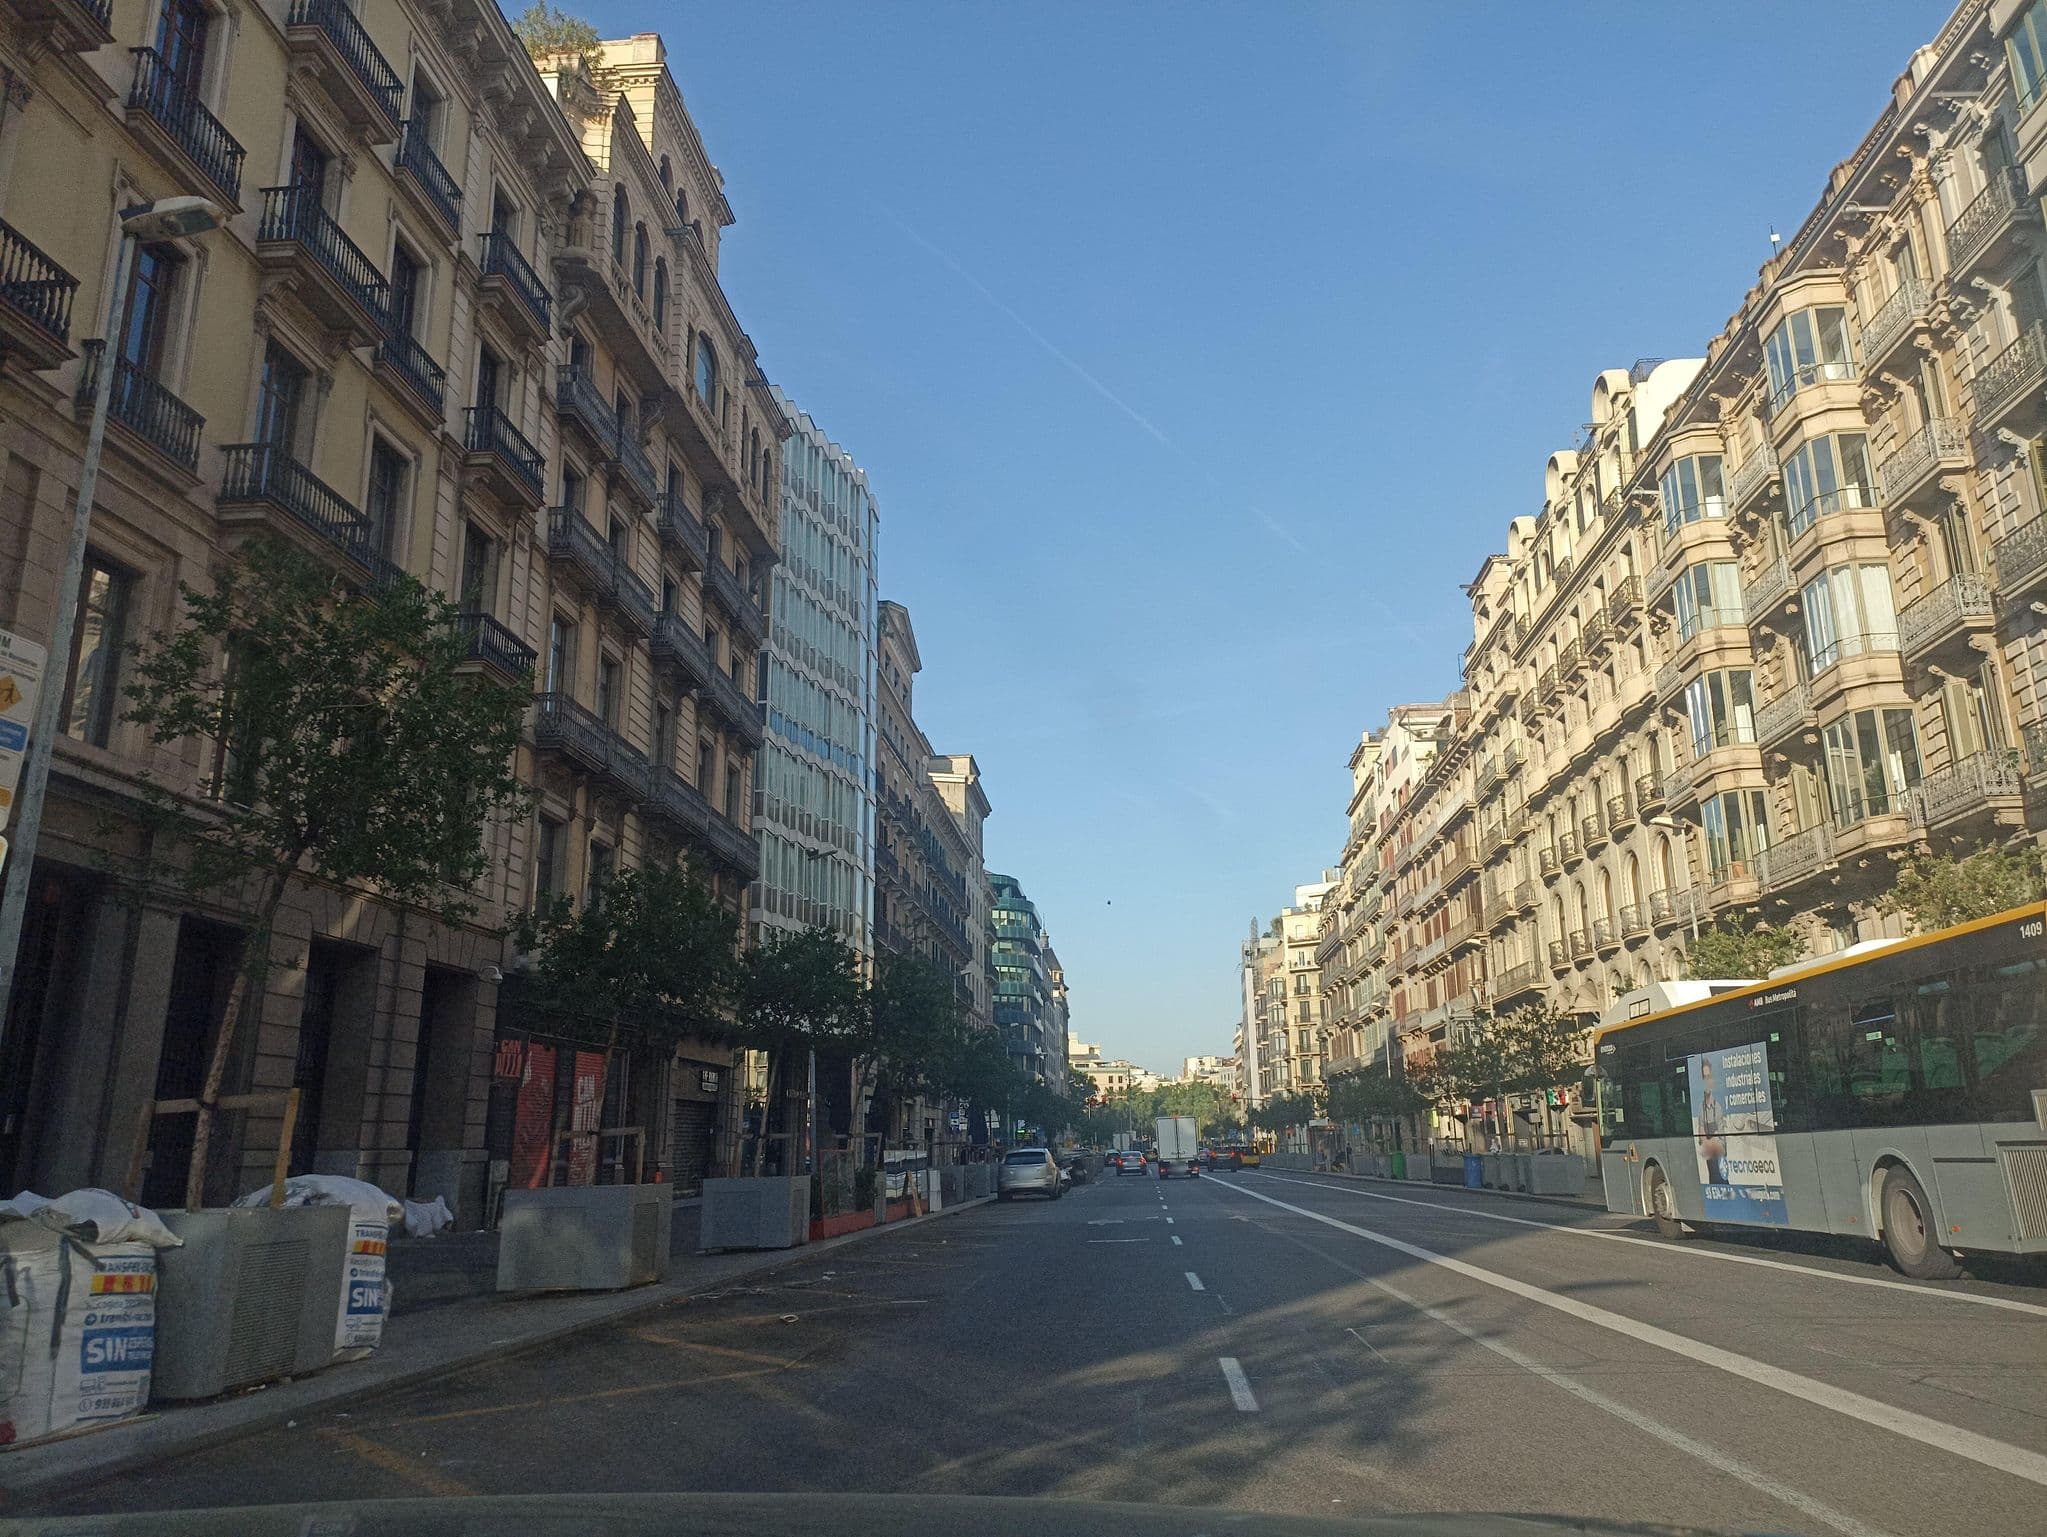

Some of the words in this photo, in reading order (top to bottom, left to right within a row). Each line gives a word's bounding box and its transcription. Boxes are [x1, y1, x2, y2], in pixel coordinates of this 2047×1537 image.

[2020, 921, 2042, 938] 1409
[1722, 1050, 1761, 1069] Instalaciones
[1726, 1069, 1761, 1087] industriales
[1724, 1095, 1729, 1110] y
[1729, 1088, 1766, 1106] comerciales
[352, 1288, 378, 1308] SIN
[87, 1337, 127, 1364] SIN
